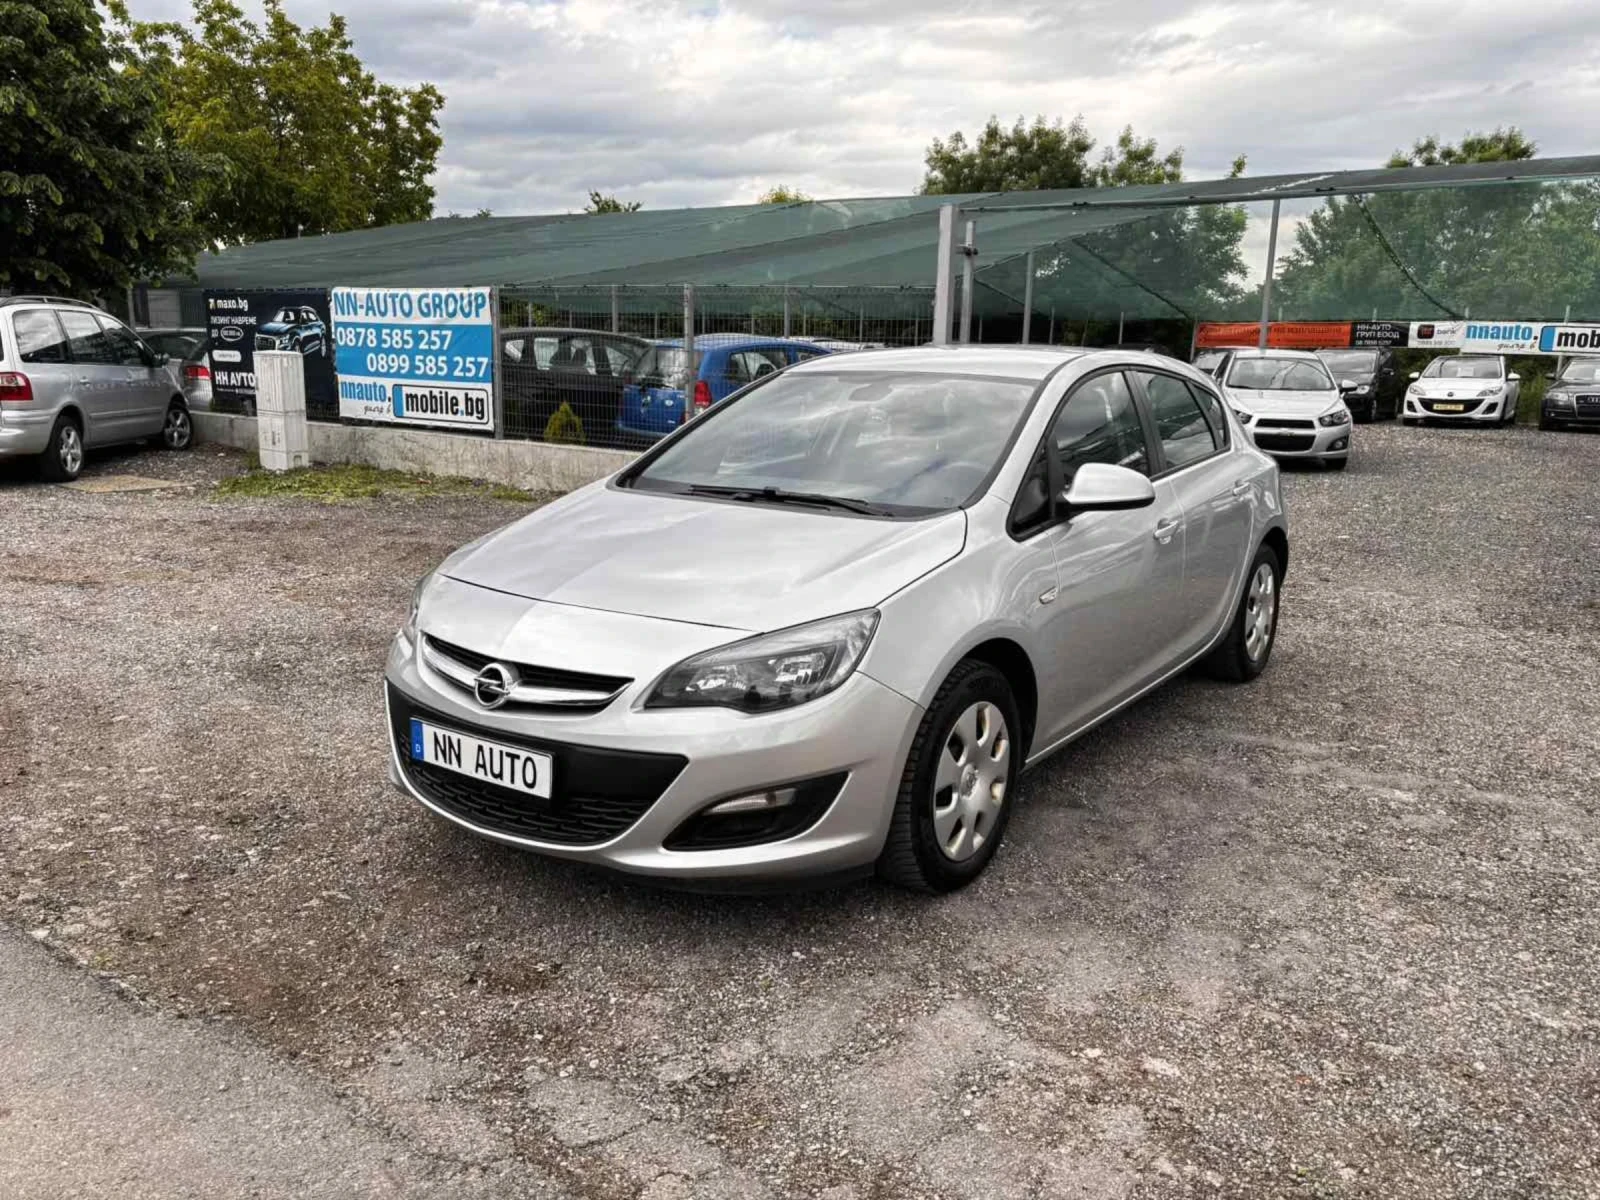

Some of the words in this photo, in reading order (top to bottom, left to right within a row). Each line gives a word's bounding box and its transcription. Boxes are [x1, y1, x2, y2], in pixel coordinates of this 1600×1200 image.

[216, 297, 249, 311] maxo.bg
[333, 292, 413, 317] NN-AUTO
[417, 291, 487, 318] GROUP
[336, 327, 377, 347] 0878
[381, 329, 414, 349] 585
[418, 330, 452, 350] 257
[366, 353, 410, 373] 0899
[415, 355, 447, 375] 585
[453, 357, 488, 377] 257
[214, 371, 229, 385] НН
[405, 390, 485, 420] mobile.bg
[433, 731, 462, 768] NN
[475, 744, 537, 789] AUTO
